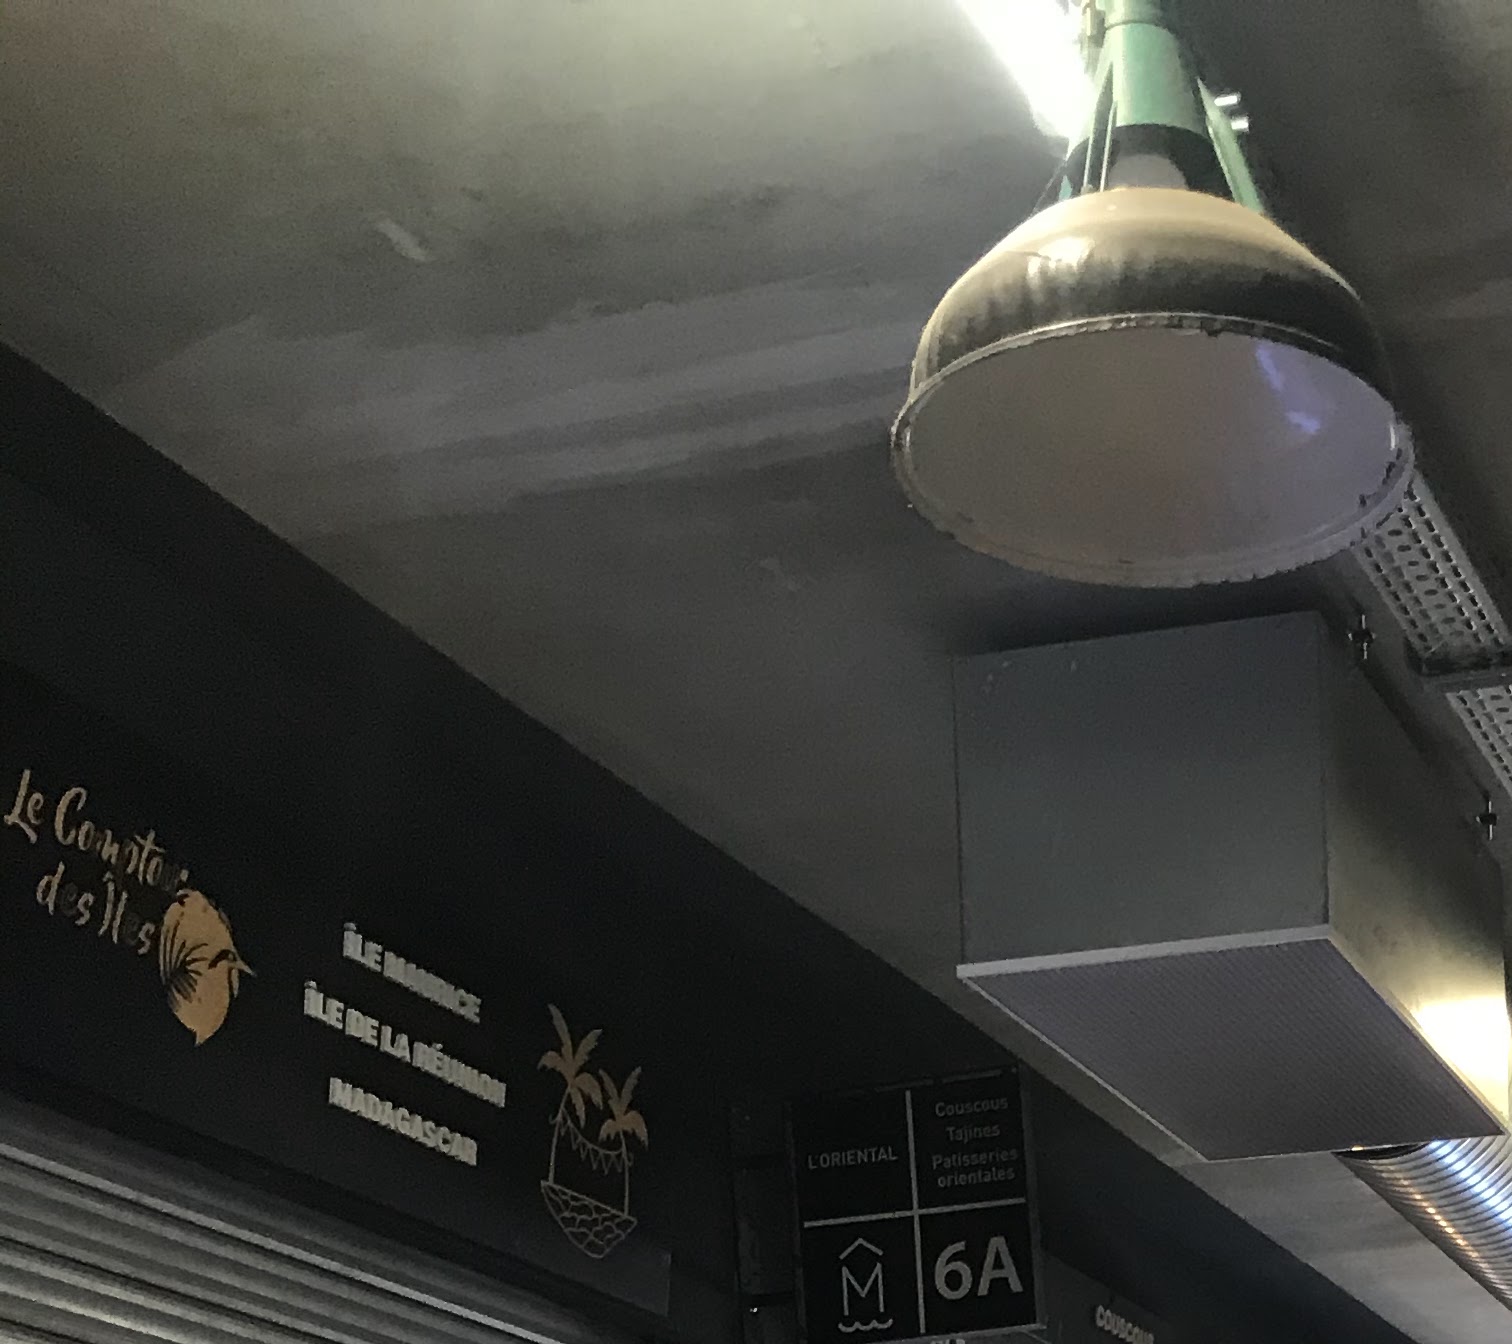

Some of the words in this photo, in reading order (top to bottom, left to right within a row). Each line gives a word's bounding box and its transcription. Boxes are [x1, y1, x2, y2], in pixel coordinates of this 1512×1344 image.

[4, 769, 44, 844] Le
[54, 786, 190, 887] Comptoir
[36, 861, 95, 926] des
[345, 1008, 379, 1047] DE
[380, 1024, 411, 1064] LA
[328, 1076, 478, 1167] MADAGASCAR
[934, 1096, 1009, 1118] Couscous
[946, 1123, 1001, 1145] Tajines
[807, 1145, 899, 1170] L'ORIENTAL
[937, 1166, 1016, 1188] orientales
[934, 1235, 1024, 1301] 6A
